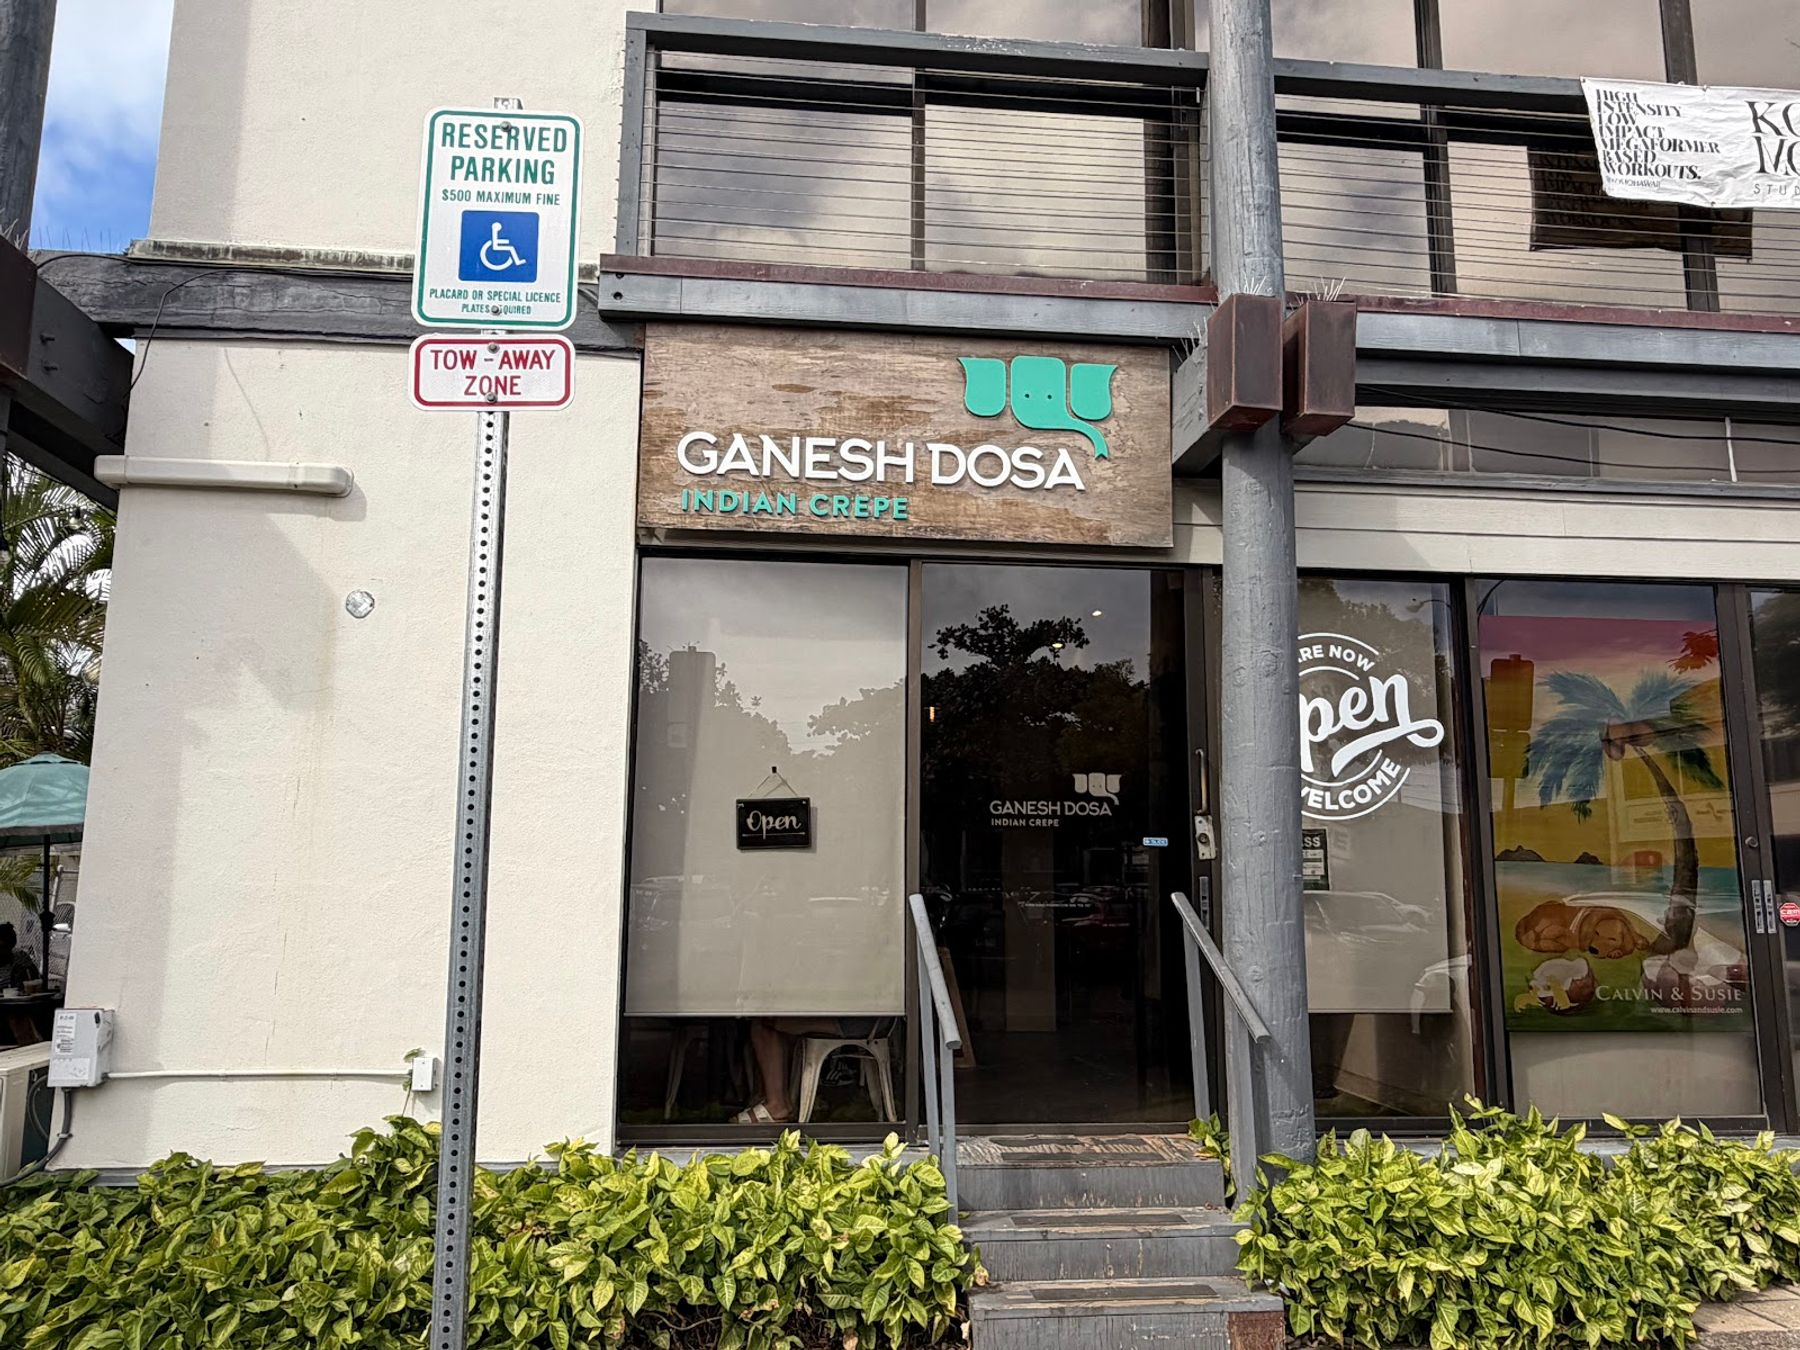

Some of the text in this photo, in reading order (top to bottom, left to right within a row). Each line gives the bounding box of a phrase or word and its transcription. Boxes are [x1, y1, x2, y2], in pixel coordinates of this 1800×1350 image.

[1596, 89, 1637, 103] HIGH
[1597, 101, 1681, 117] INTENSITY
[1599, 113, 1638, 125] LOW
[441, 122, 567, 152] RESERVED
[1599, 126, 1664, 138] IMPACT
[1602, 138, 1721, 153] MEGAFORMER
[1603, 150, 1656, 163] BASED
[450, 155, 555, 184] PARKING
[1603, 162, 1702, 180] WORKOUTS.
[442, 188, 561, 205] $500 MAXIMUM FINE
[430, 288, 561, 303] PLACARD OR SPECIAL LICENCE
[462, 303, 531, 315] PLATES QUIRED
[430, 349, 477, 370] TOW
[498, 349, 556, 370] AWAY
[464, 375, 521, 396] ZONE
[677, 430, 1086, 491] GANESH DOSA
[681, 488, 910, 520] INDIAN CREPE
[1298, 644, 1375, 672] RE NOW
[1299, 673, 1445, 777] pen
[990, 800, 1112, 816] GANESH DOSA
[746, 810, 801, 839] Open
[992, 818, 1059, 827] INDIAN CREPE
[1671, 986, 1684, 1001] &
[1651, 1005, 1743, 1014] www.calvinandsusie.com
